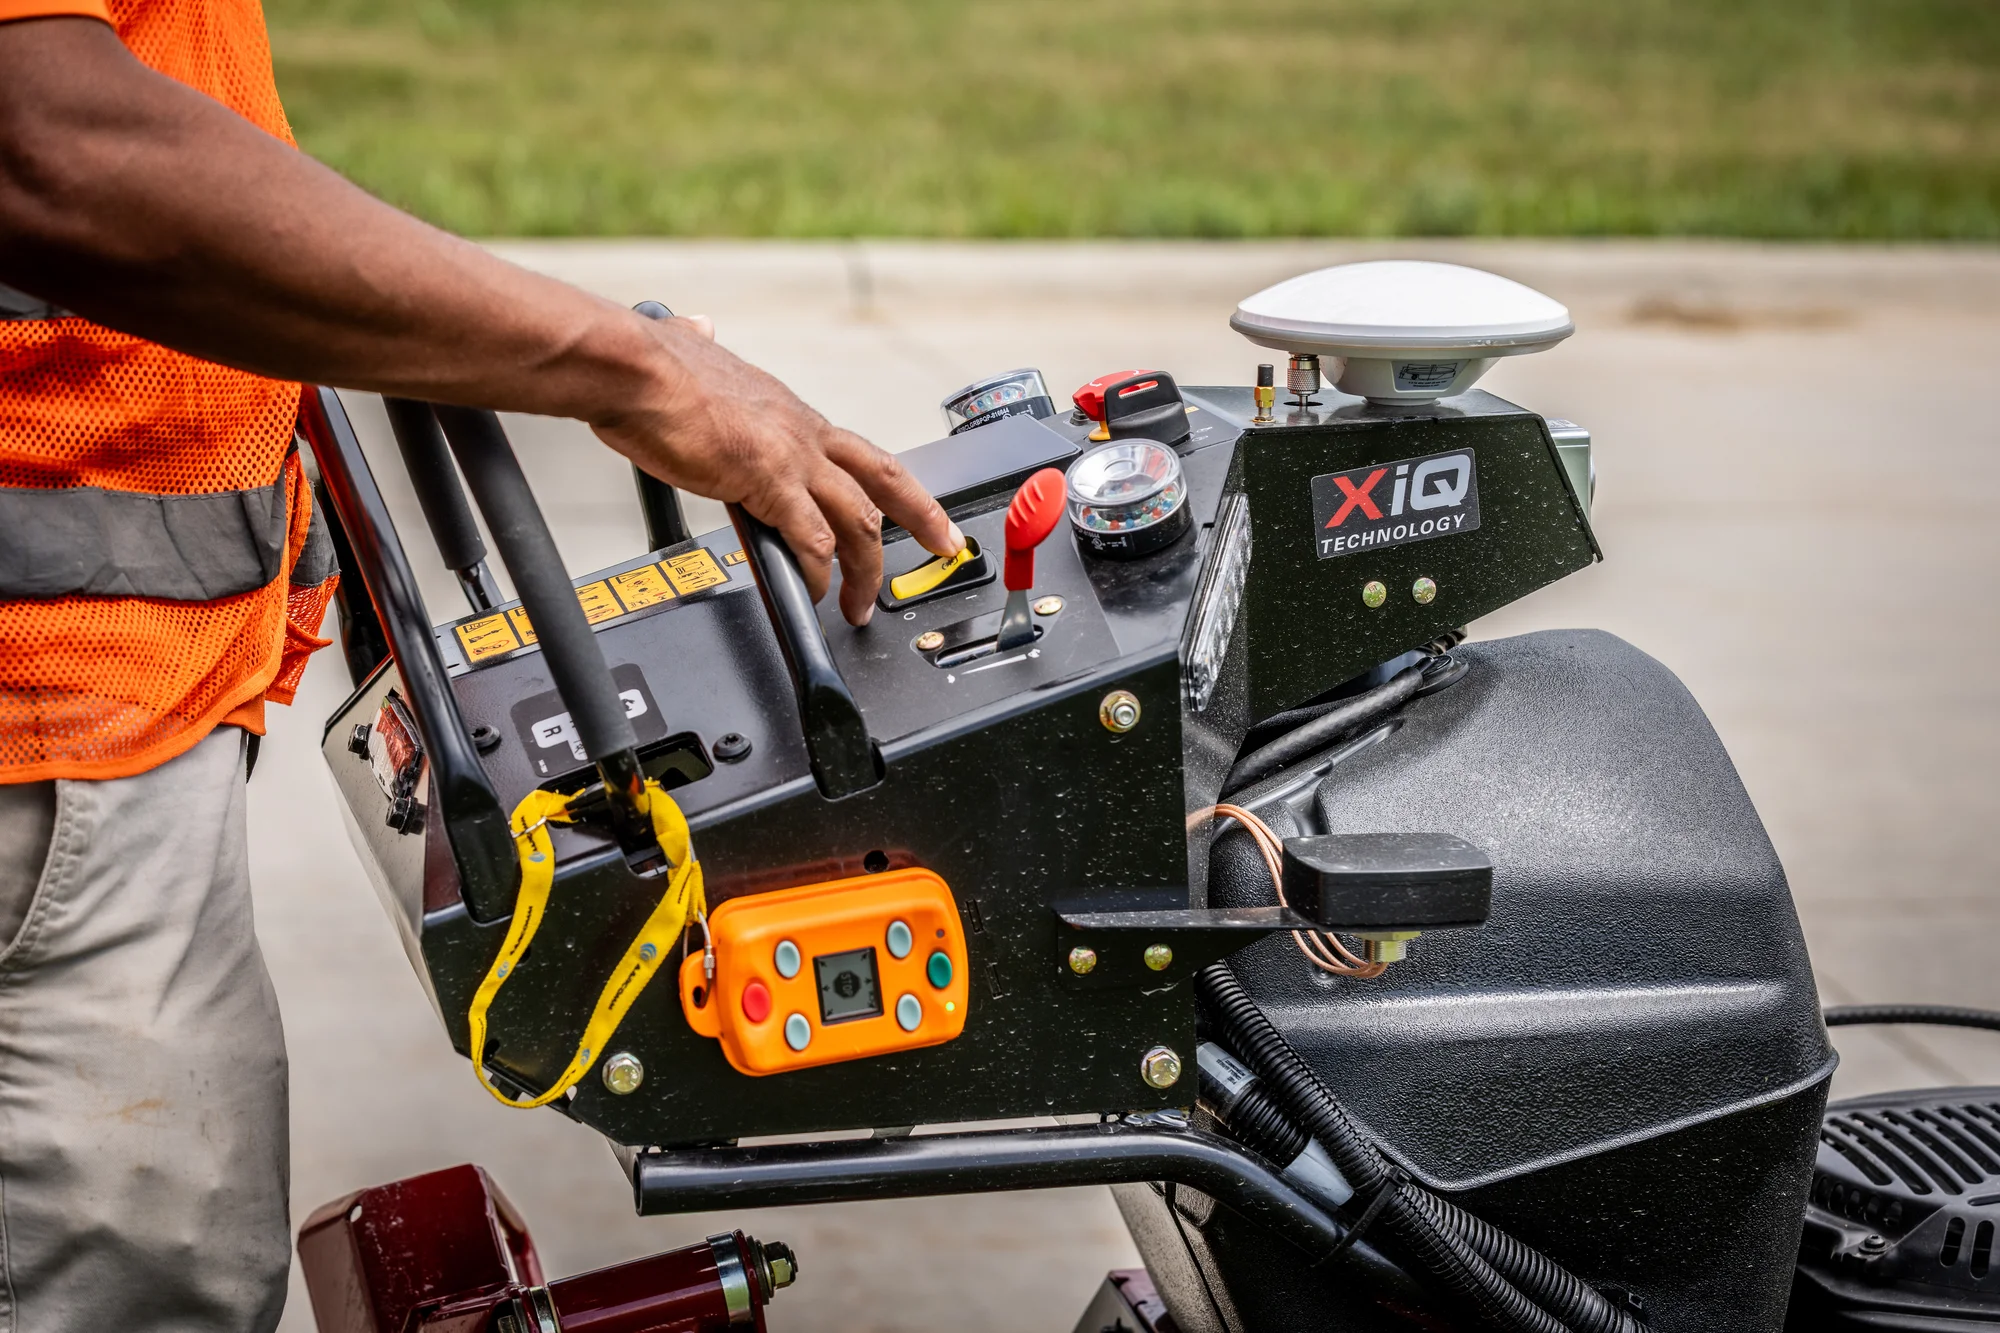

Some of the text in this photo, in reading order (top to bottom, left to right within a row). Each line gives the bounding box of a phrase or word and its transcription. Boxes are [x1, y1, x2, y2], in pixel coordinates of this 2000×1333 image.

[1324, 454, 1471, 529] XiQ
[1321, 513, 1466, 554] TECHNOLOGY
[543, 725, 562, 738] R
[840, 972, 853, 996] STOP
